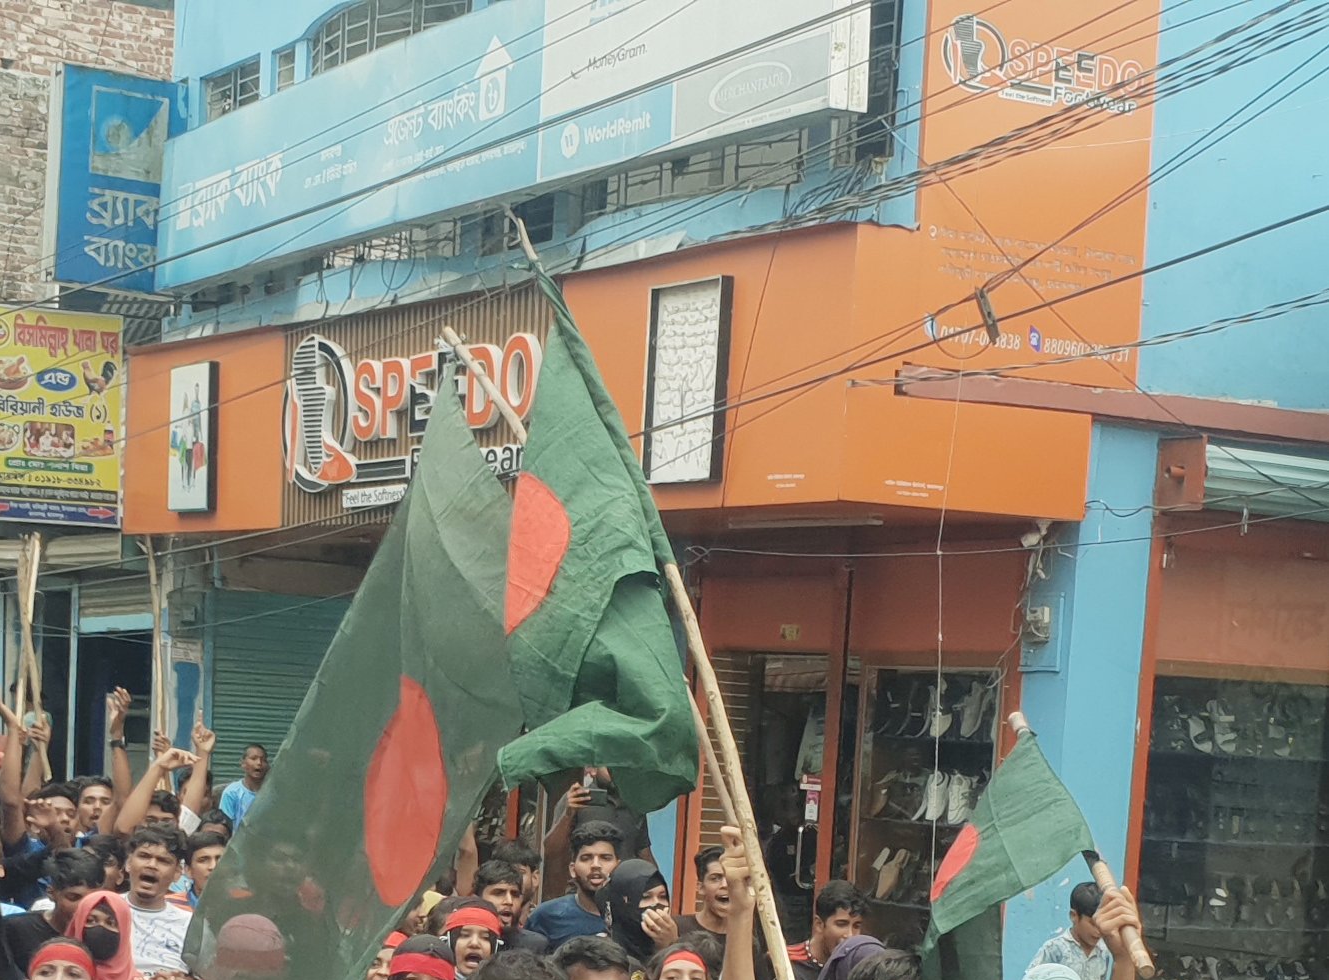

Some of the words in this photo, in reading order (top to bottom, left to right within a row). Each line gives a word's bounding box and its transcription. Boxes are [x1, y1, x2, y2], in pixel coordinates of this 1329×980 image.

[586, 43, 646, 71] MoneyGram
[1008, 38, 1144, 93] SPEEDO
[583, 111, 651, 144] WorldRemit
[352, 332, 543, 442] SPEDO
